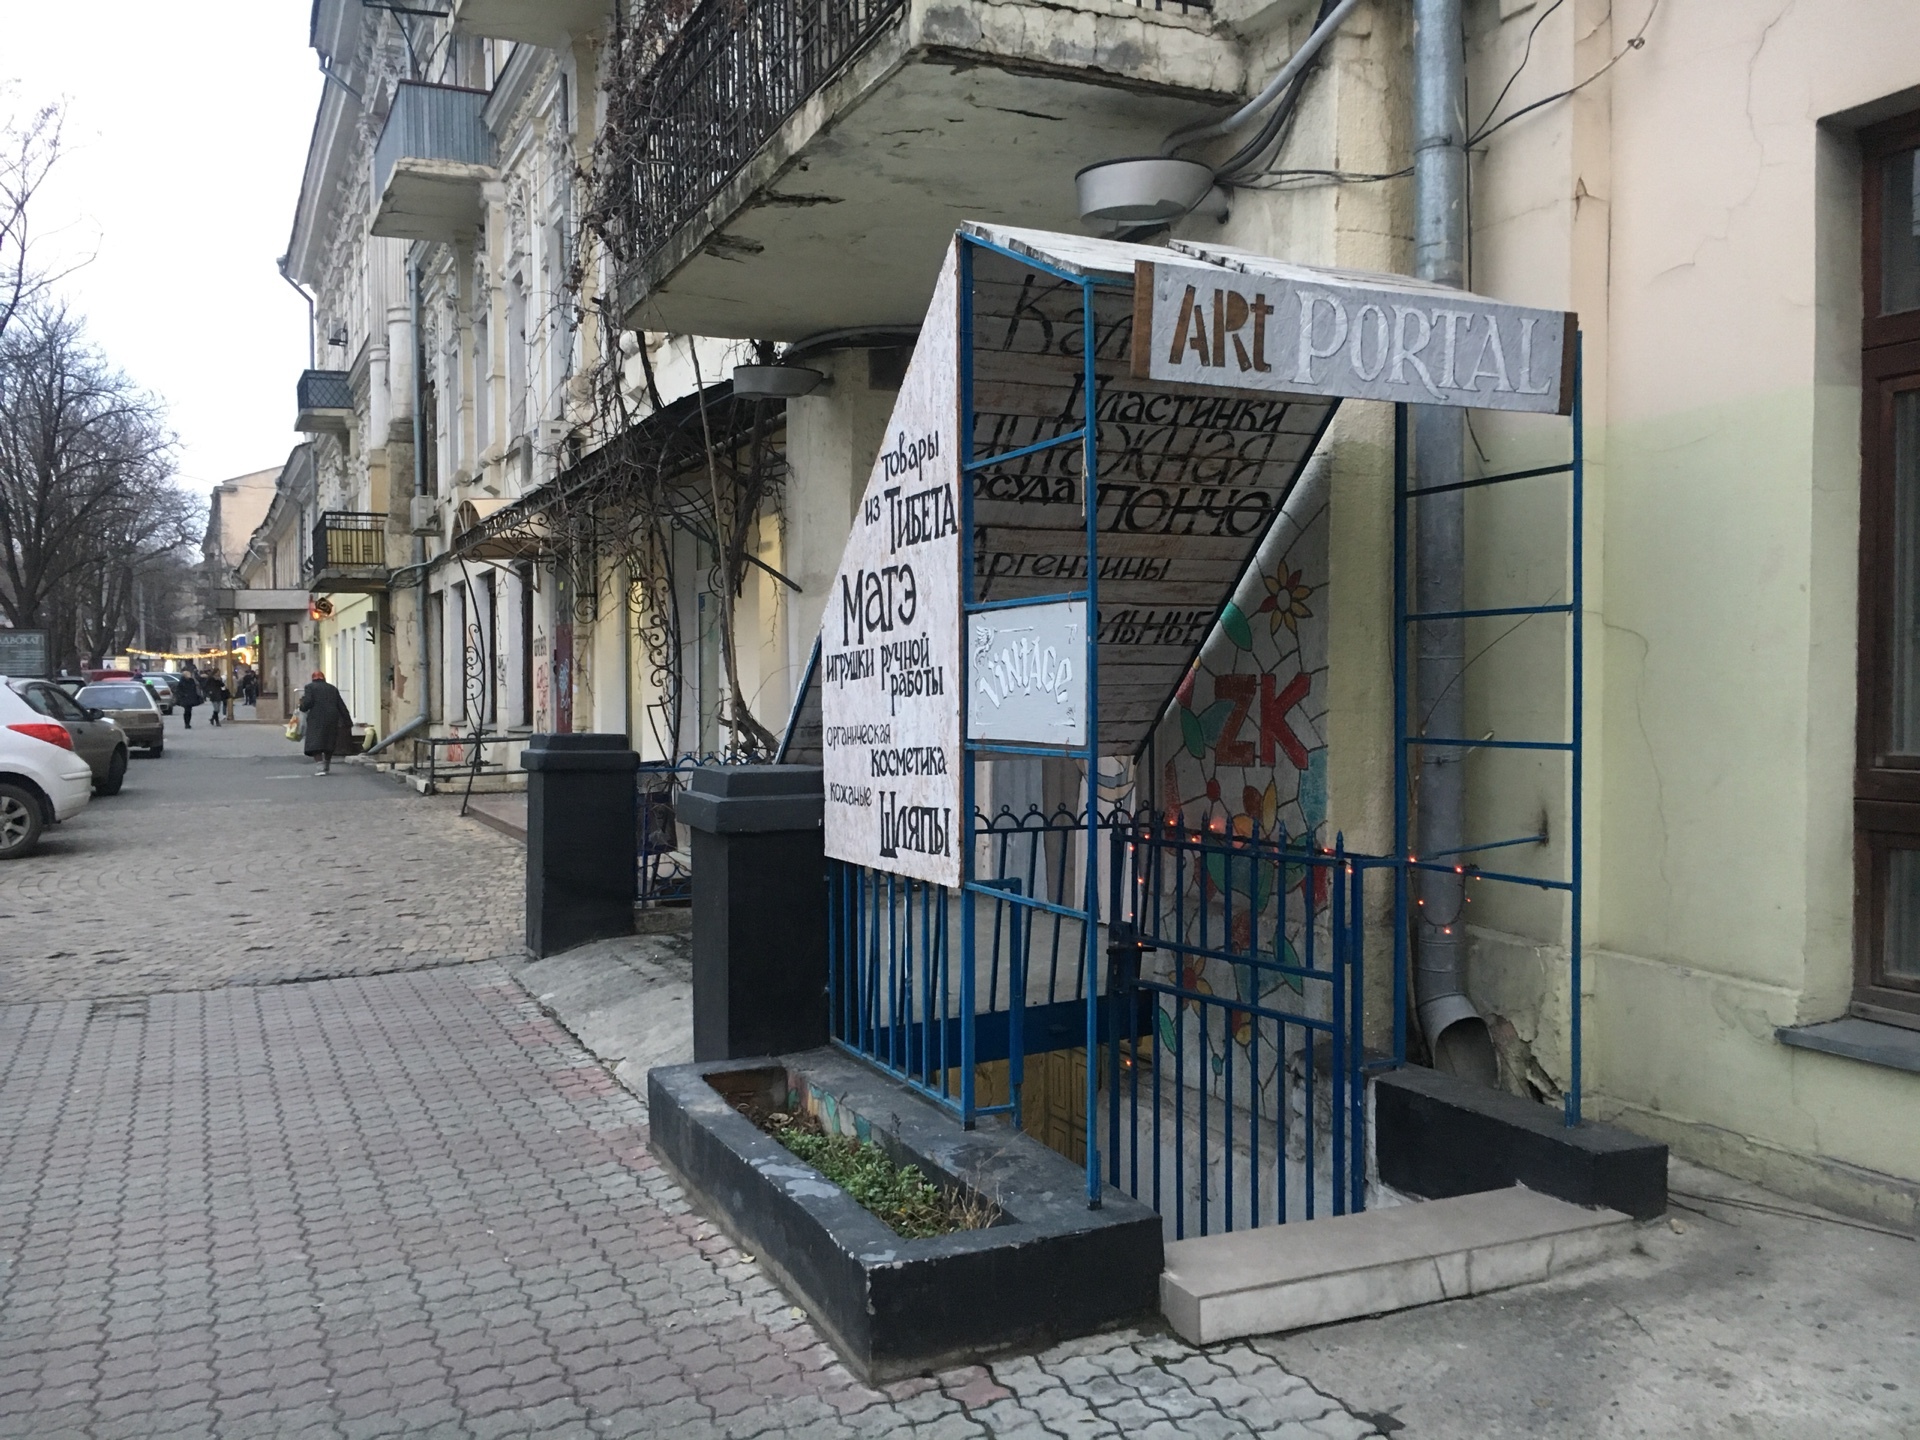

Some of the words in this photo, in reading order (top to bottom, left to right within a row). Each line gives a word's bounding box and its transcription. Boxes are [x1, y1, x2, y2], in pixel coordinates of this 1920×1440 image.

[1289, 289, 1553, 400] PORTAL
[881, 430, 939, 482] товары
[865, 495, 881, 527] из
[826, 723, 891, 751] органическая
[870, 746, 948, 777] косметика
[830, 781, 873, 807] кожаные
